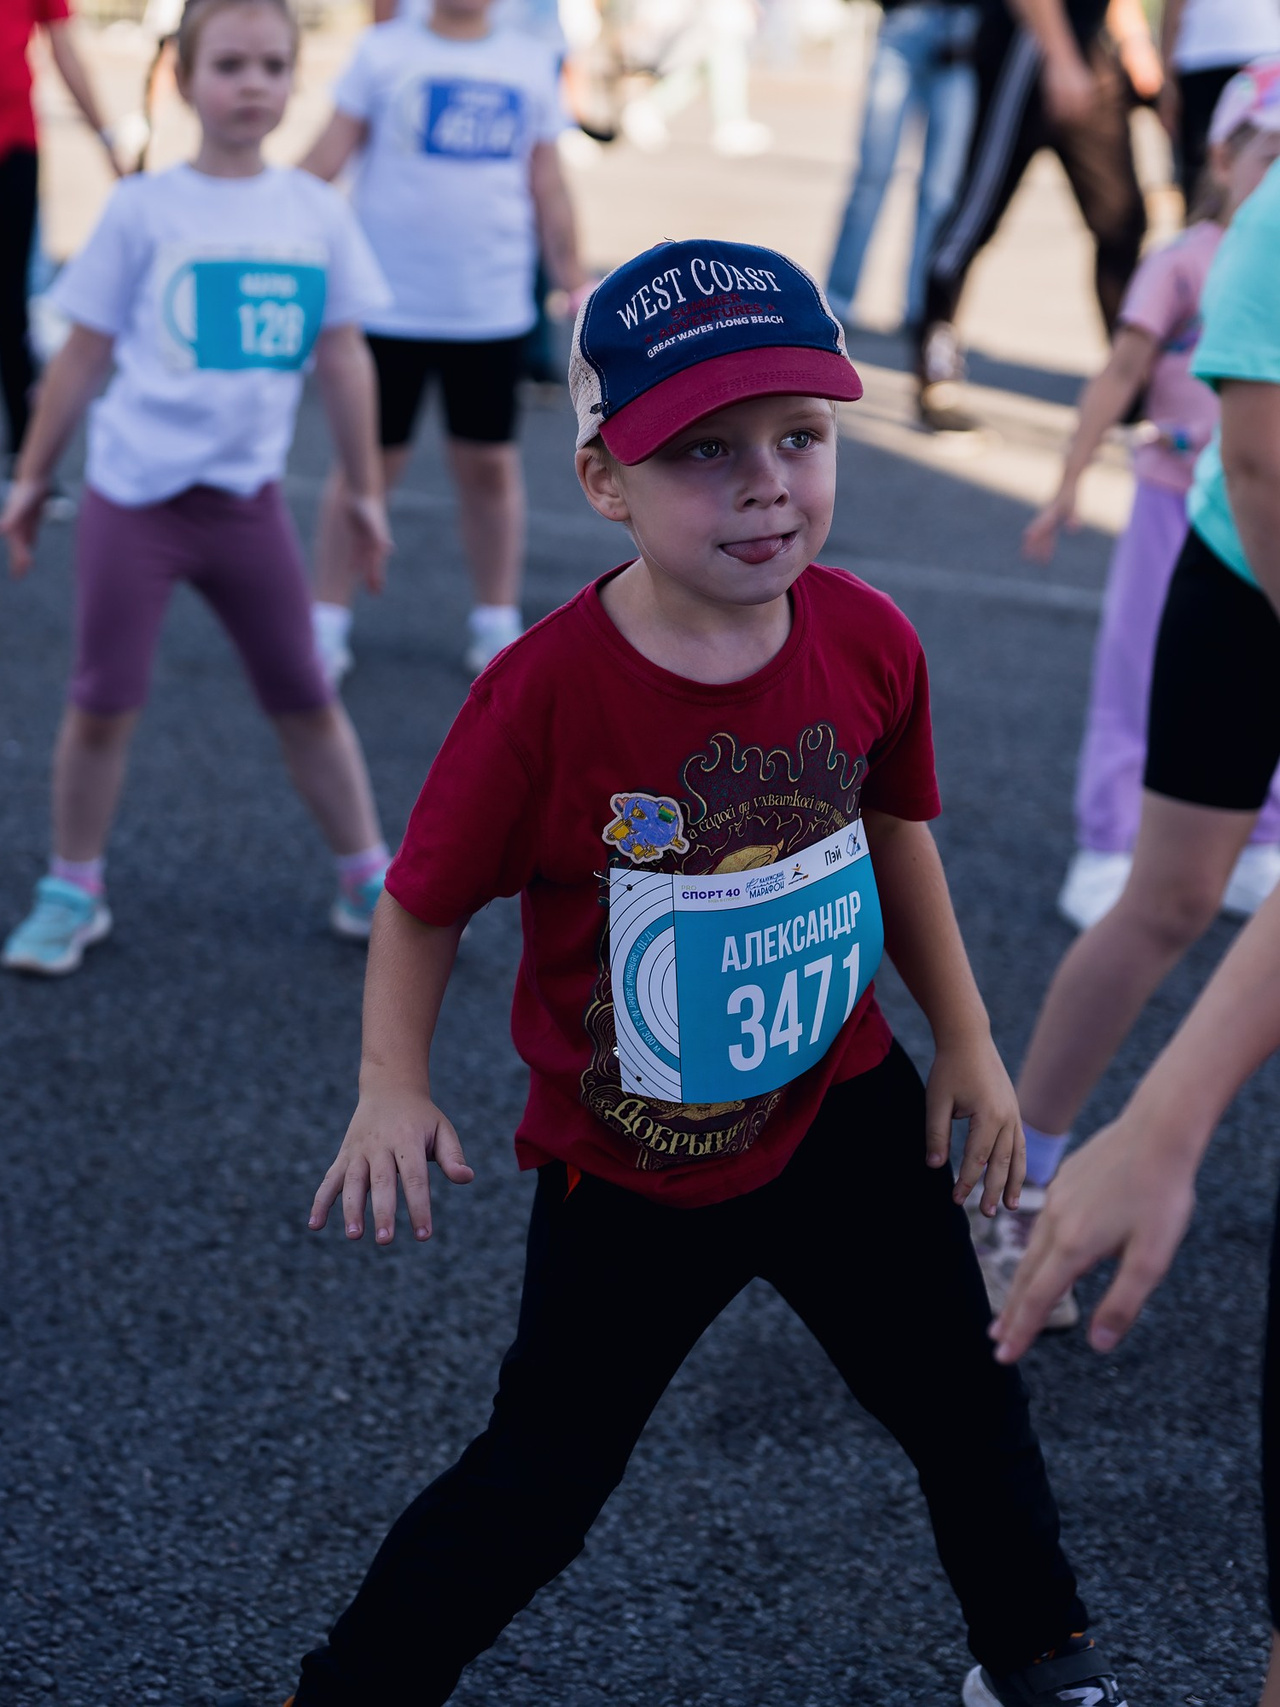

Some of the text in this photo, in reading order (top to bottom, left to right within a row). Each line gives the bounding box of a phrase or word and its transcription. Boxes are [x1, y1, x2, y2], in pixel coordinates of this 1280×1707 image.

[616, 258, 782, 330] WEST COAST
[670, 292, 742, 321] SUMMER
[658, 303, 764, 340] ADVENTURES
[646, 337, 676, 359] GREAT
[677, 323, 714, 342] WAVES
[750, 315, 785, 324] BEACH
[824, 844, 842, 867] Пэй
[682, 889, 723, 900] СПОРТ
[725, 888, 740, 897] 40
[749, 881, 785, 899] МАРАФОН
[637, 930, 655, 950] 17:10
[721, 890, 861, 973] АЛЕКСАНДР
[625, 987, 637, 1009] забег
[726, 942, 860, 1072] 3471
[641, 1031, 656, 1046] 300
